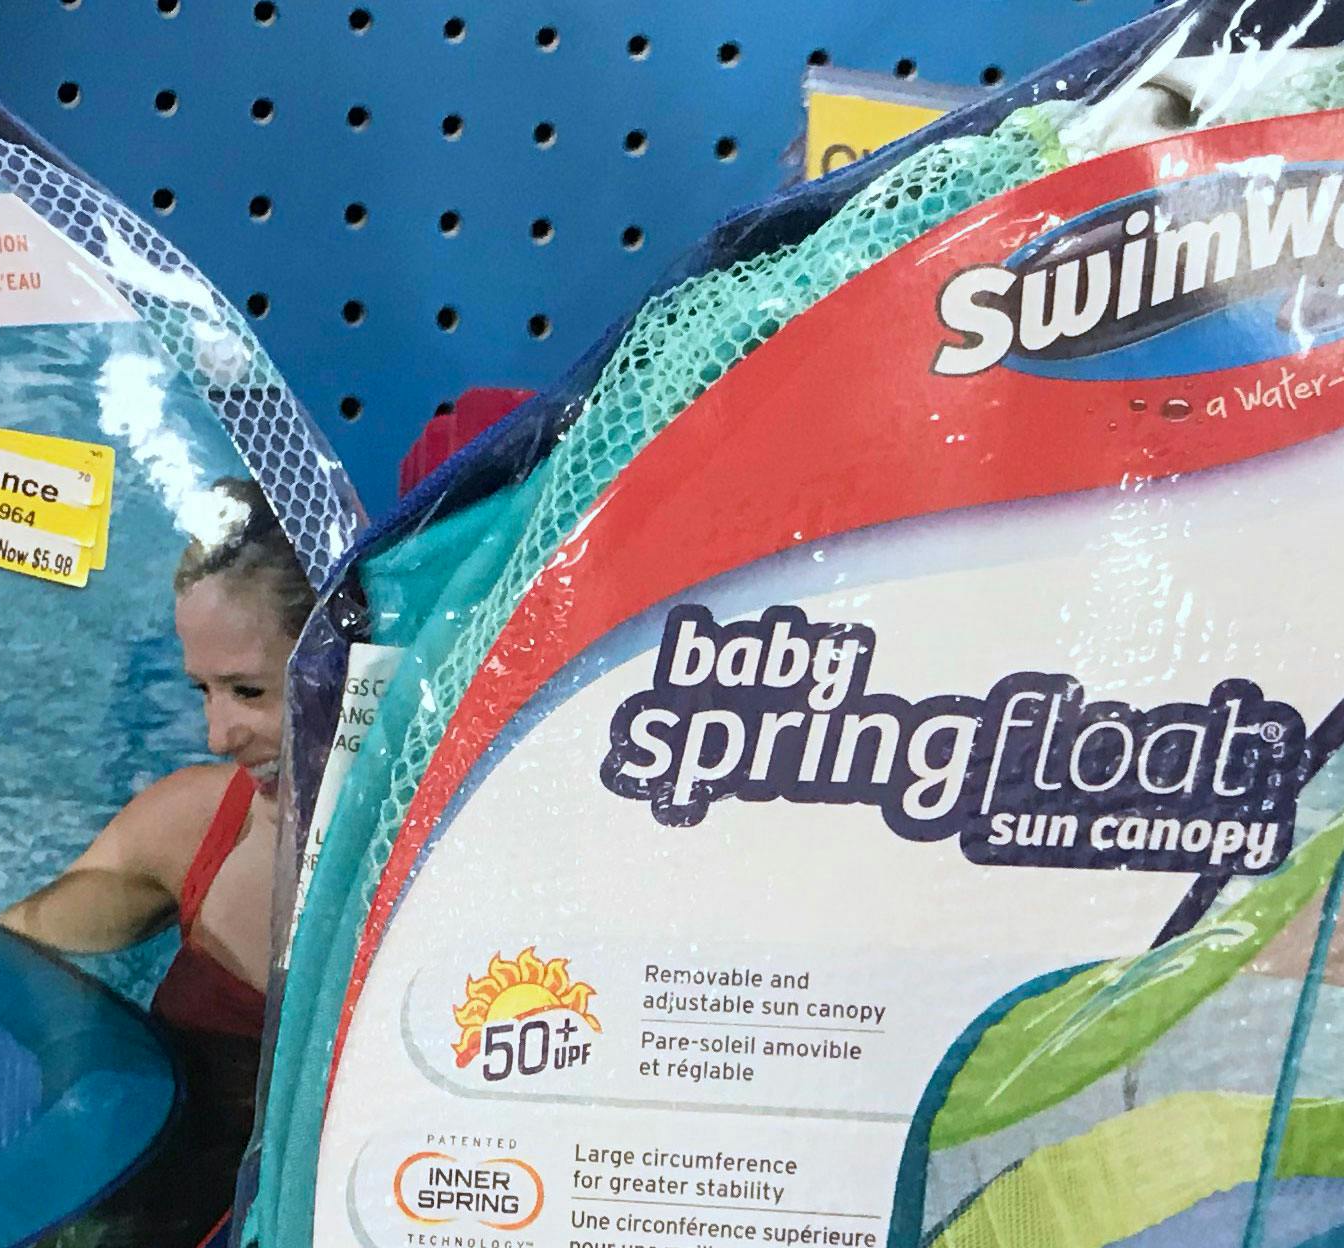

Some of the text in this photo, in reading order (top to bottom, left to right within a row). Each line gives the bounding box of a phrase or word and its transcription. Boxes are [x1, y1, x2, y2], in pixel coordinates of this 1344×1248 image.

[1206, 395, 1227, 418] a
[32, 547, 74, 577] $5.98
[667, 622, 858, 712] baby
[987, 810, 1280, 868] sun canopy
[645, 965, 809, 990] Removable and
[643, 992, 886, 1025] adjustable sun canopy
[554, 1043, 592, 1070] UPF
[641, 1031, 862, 1061] Pare-soleil amovible
[639, 1059, 755, 1083] et réglable
[426, 1134, 518, 1150] PATENTED
[575, 1143, 797, 1175] Large circumference
[429, 1166, 511, 1190] INNER
[573, 1171, 785, 1205] for greater stability
[417, 1189, 520, 1214] SPRING
[571, 1211, 610, 1231] Une
[616, 1214, 756, 1243] circonférence
